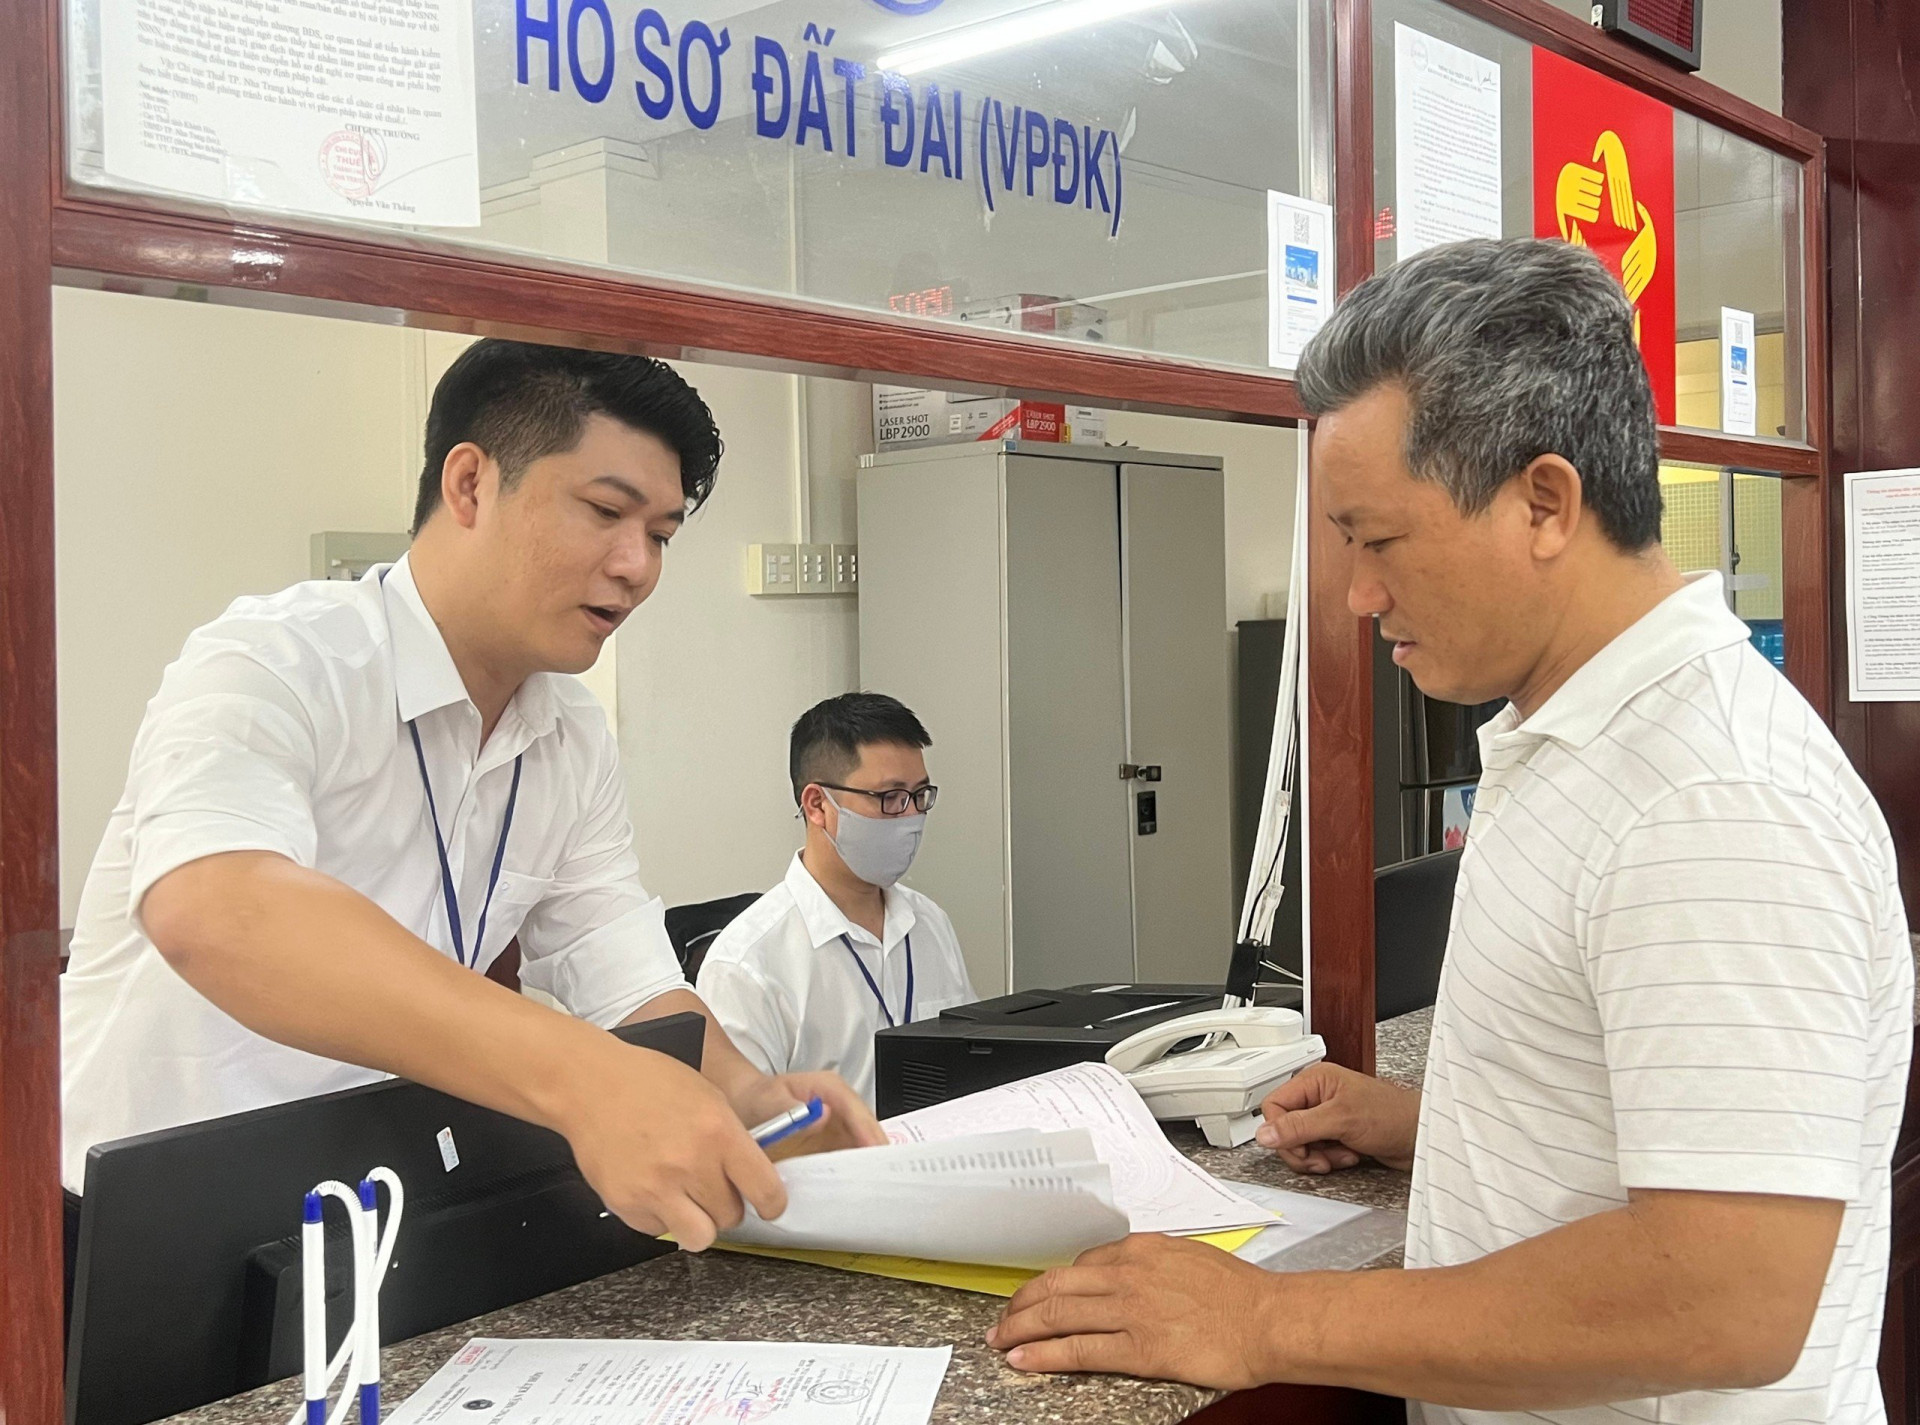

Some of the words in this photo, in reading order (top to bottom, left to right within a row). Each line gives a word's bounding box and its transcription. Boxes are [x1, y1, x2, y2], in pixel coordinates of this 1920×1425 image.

[635, 9, 731, 130] SƠ
[752, 22, 865, 156] ĐẤT
[879, 71, 963, 181] ĐAI
[979, 97, 1124, 238] (VPĐK)
[879, 415, 905, 427] LASER
[906, 413, 929, 424] SHOT
